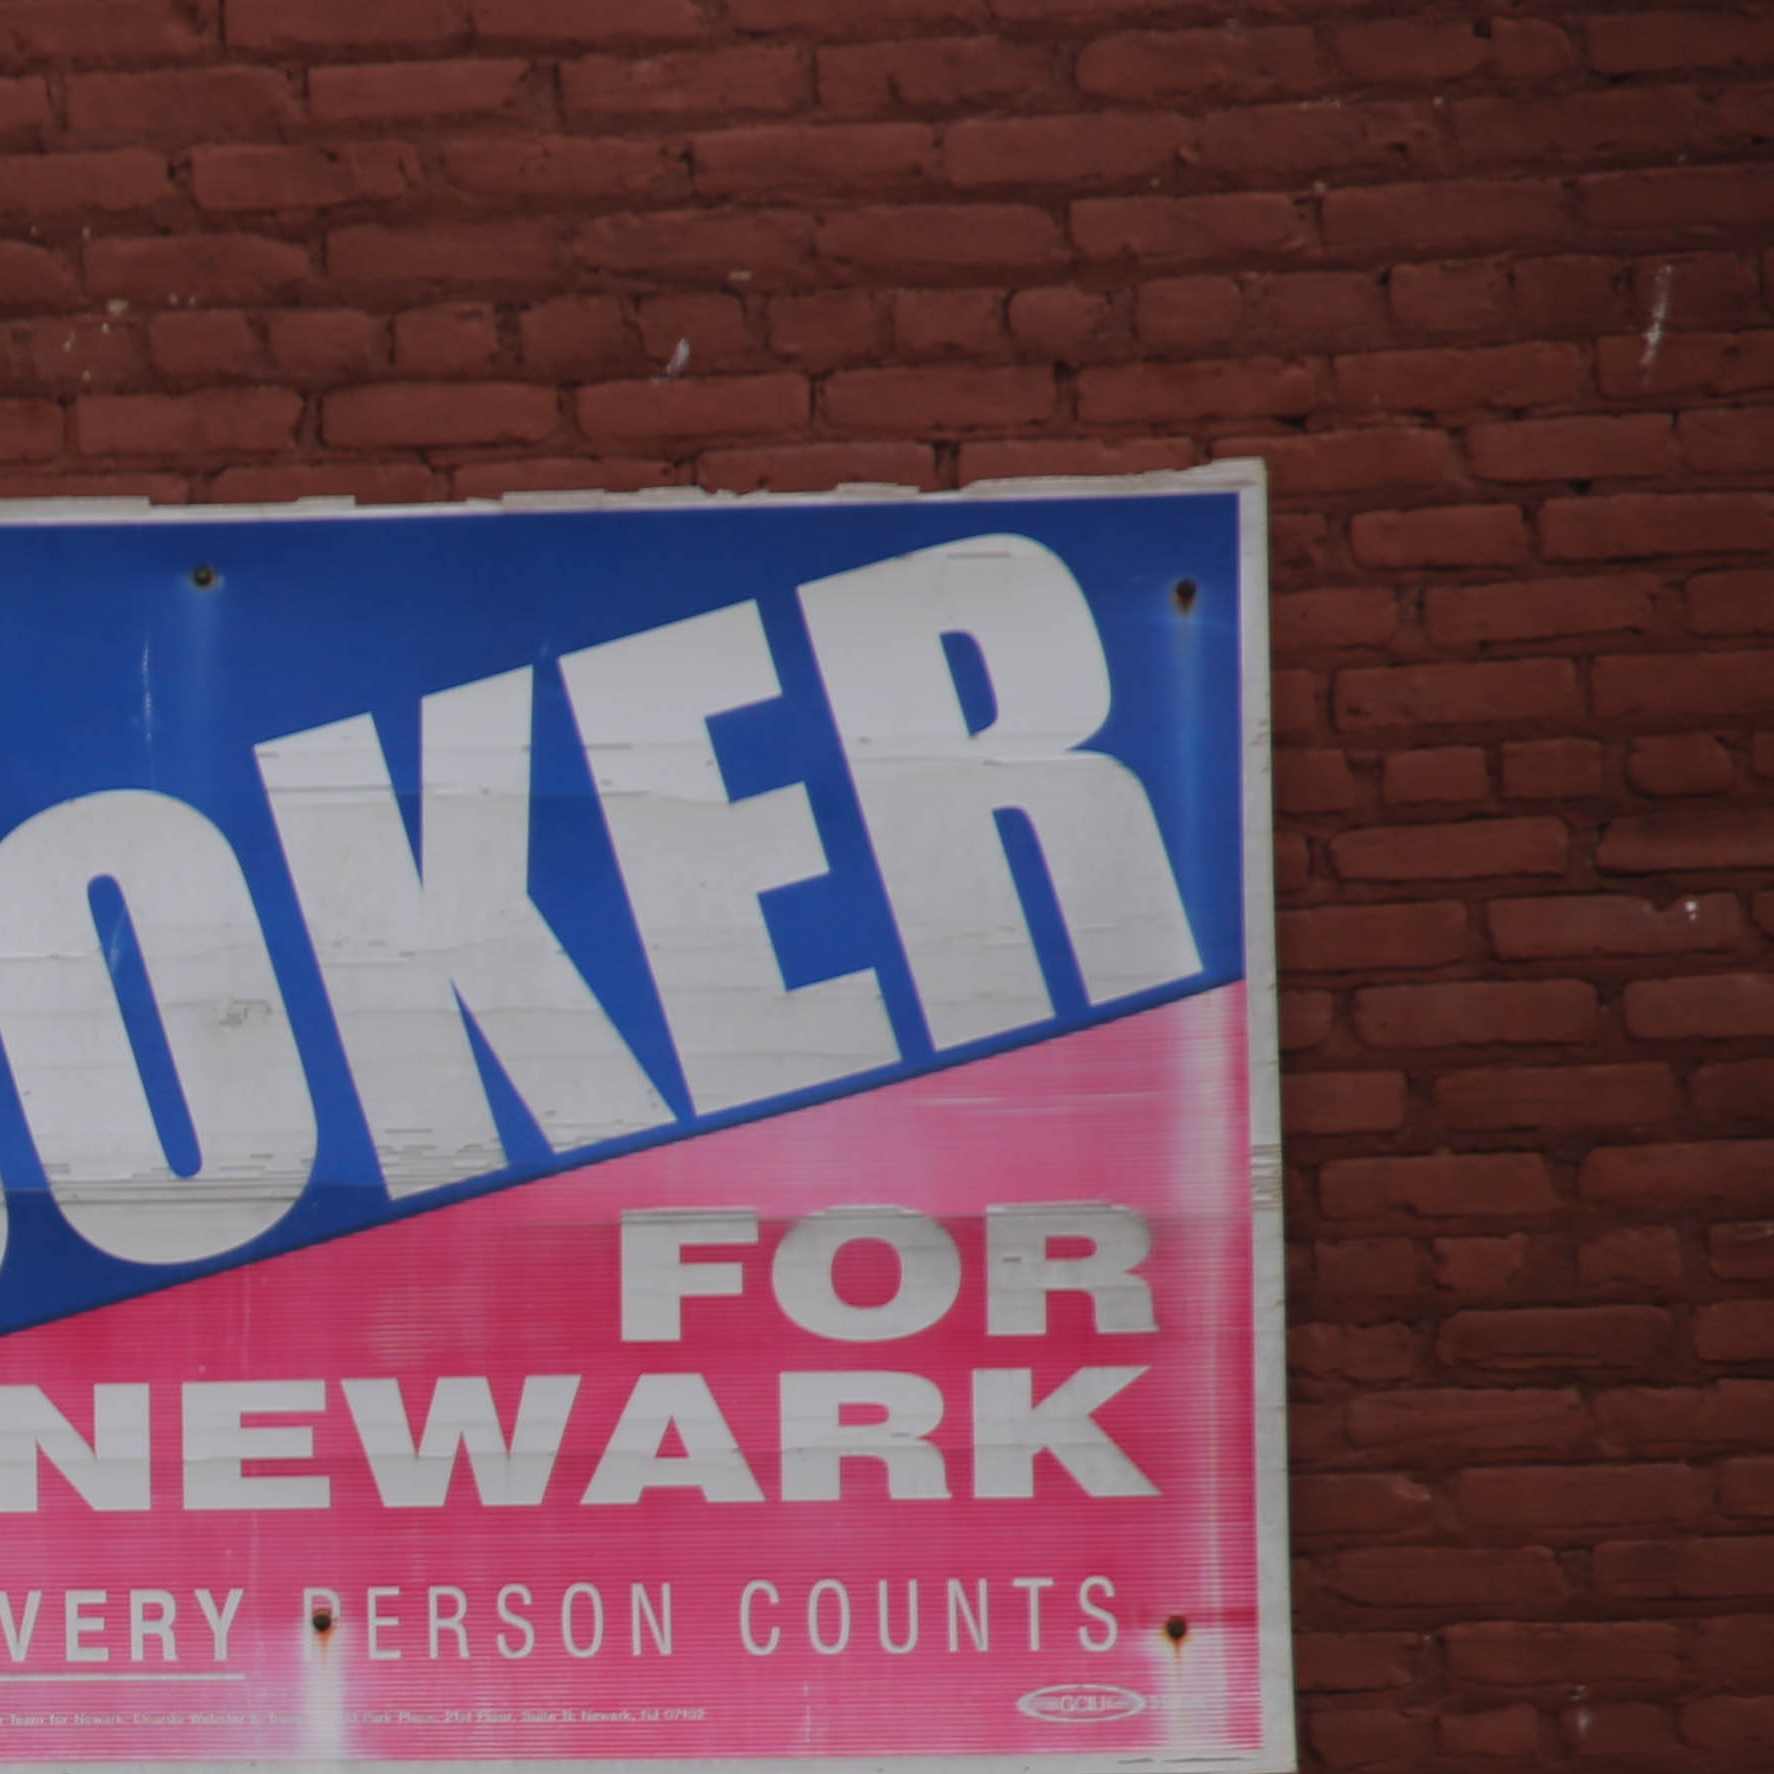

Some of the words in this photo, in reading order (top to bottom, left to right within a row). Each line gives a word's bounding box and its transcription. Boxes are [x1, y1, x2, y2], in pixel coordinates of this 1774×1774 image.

[620, 1202, 1161, 1344] FOR
[300, 1580, 674, 1661] PERSON
[739, 1575, 1121, 1657] COUNTS
